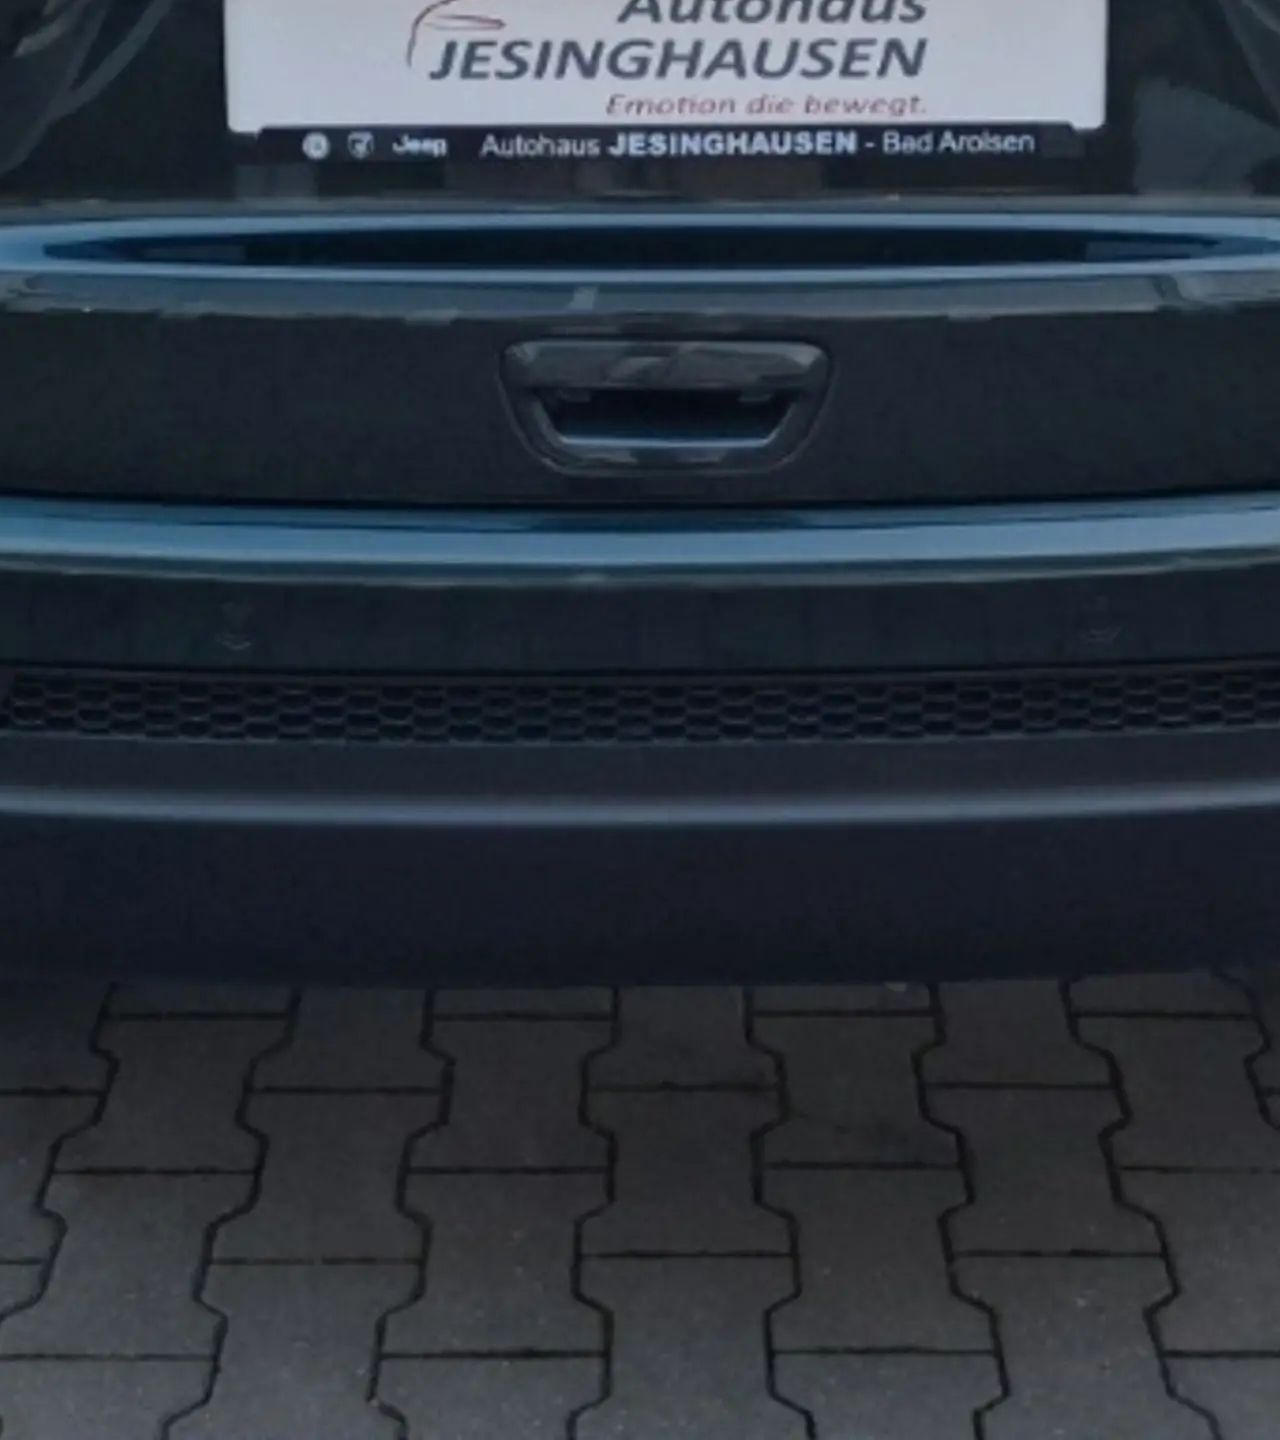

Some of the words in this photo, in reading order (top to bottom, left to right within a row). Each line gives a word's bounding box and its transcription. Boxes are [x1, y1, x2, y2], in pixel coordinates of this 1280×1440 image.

[429, 38, 928, 81] JESINGHAUSEN
[606, 93, 736, 117] Emotion
[745, 92, 793, 117] die
[804, 92, 928, 119] bewegt.
[392, 133, 448, 158] Jeep
[480, 133, 601, 157] Autohaus
[608, 130, 857, 156] JESINGHAUSEN
[882, 130, 933, 154] Bad
[936, 130, 1036, 155] Arolsen
